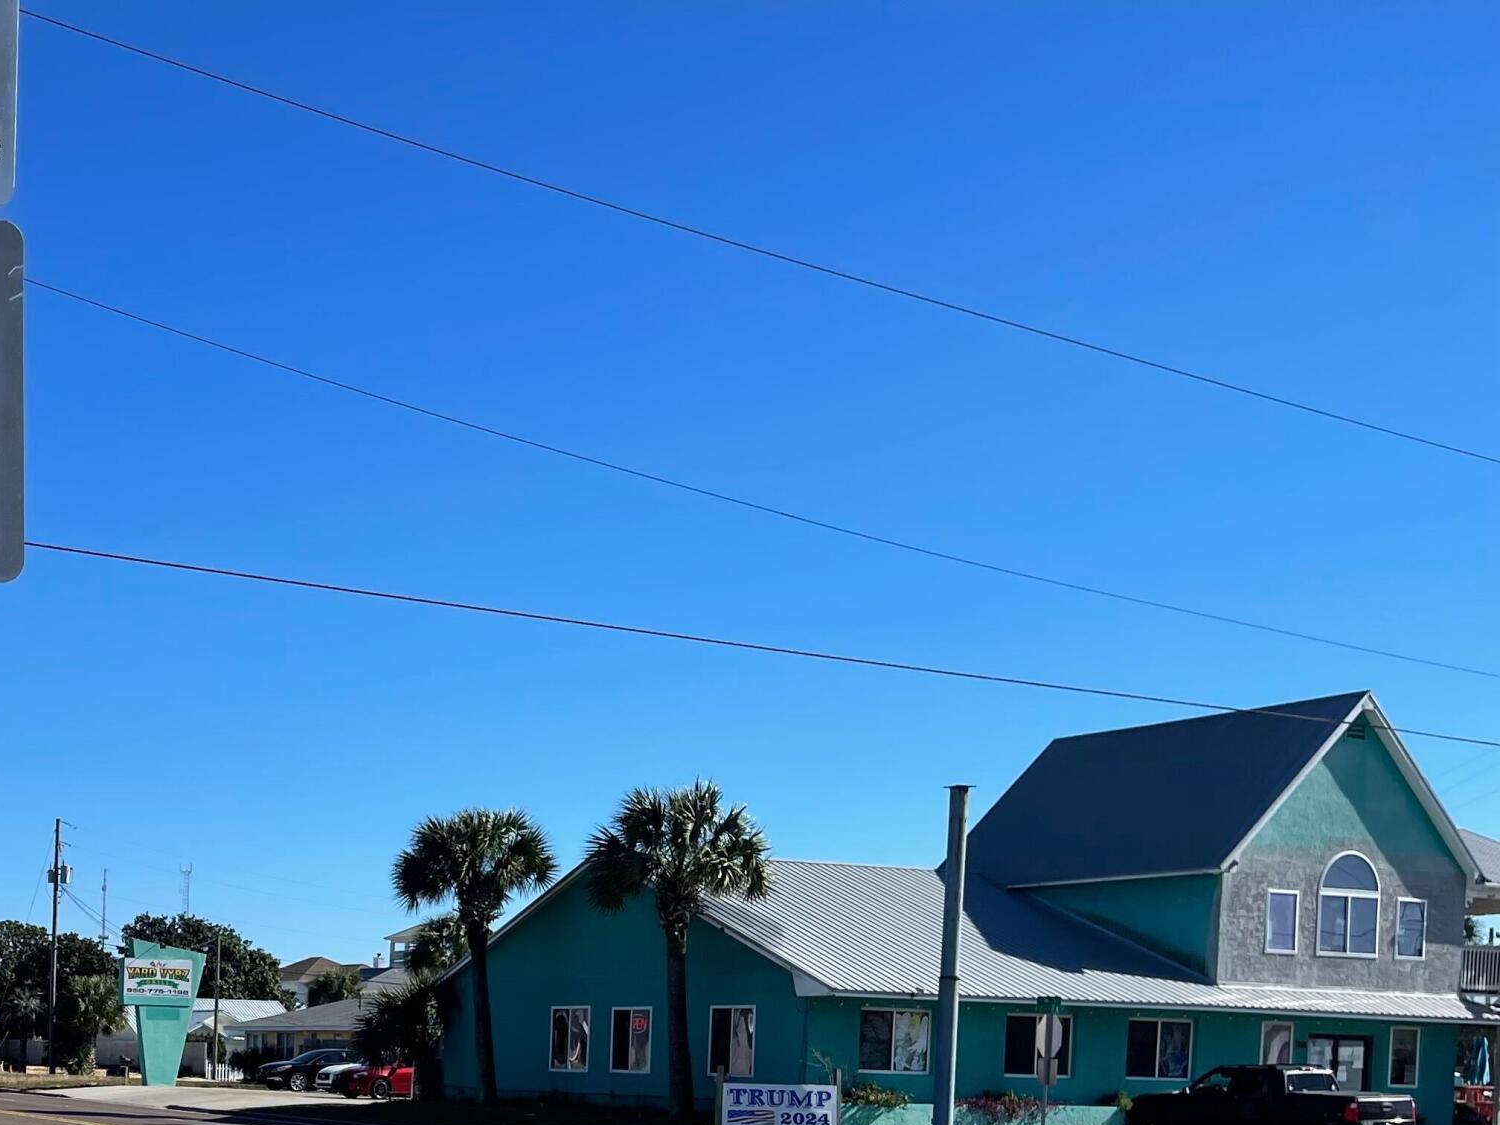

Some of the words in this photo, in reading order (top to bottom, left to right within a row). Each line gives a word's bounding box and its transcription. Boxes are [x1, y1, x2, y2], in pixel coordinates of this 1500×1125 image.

[127, 967, 157, 979] YARD
[160, 969, 190, 982] VYBZ
[728, 1088, 832, 1109] TRUMP
[780, 1112, 830, 1125] 2024
